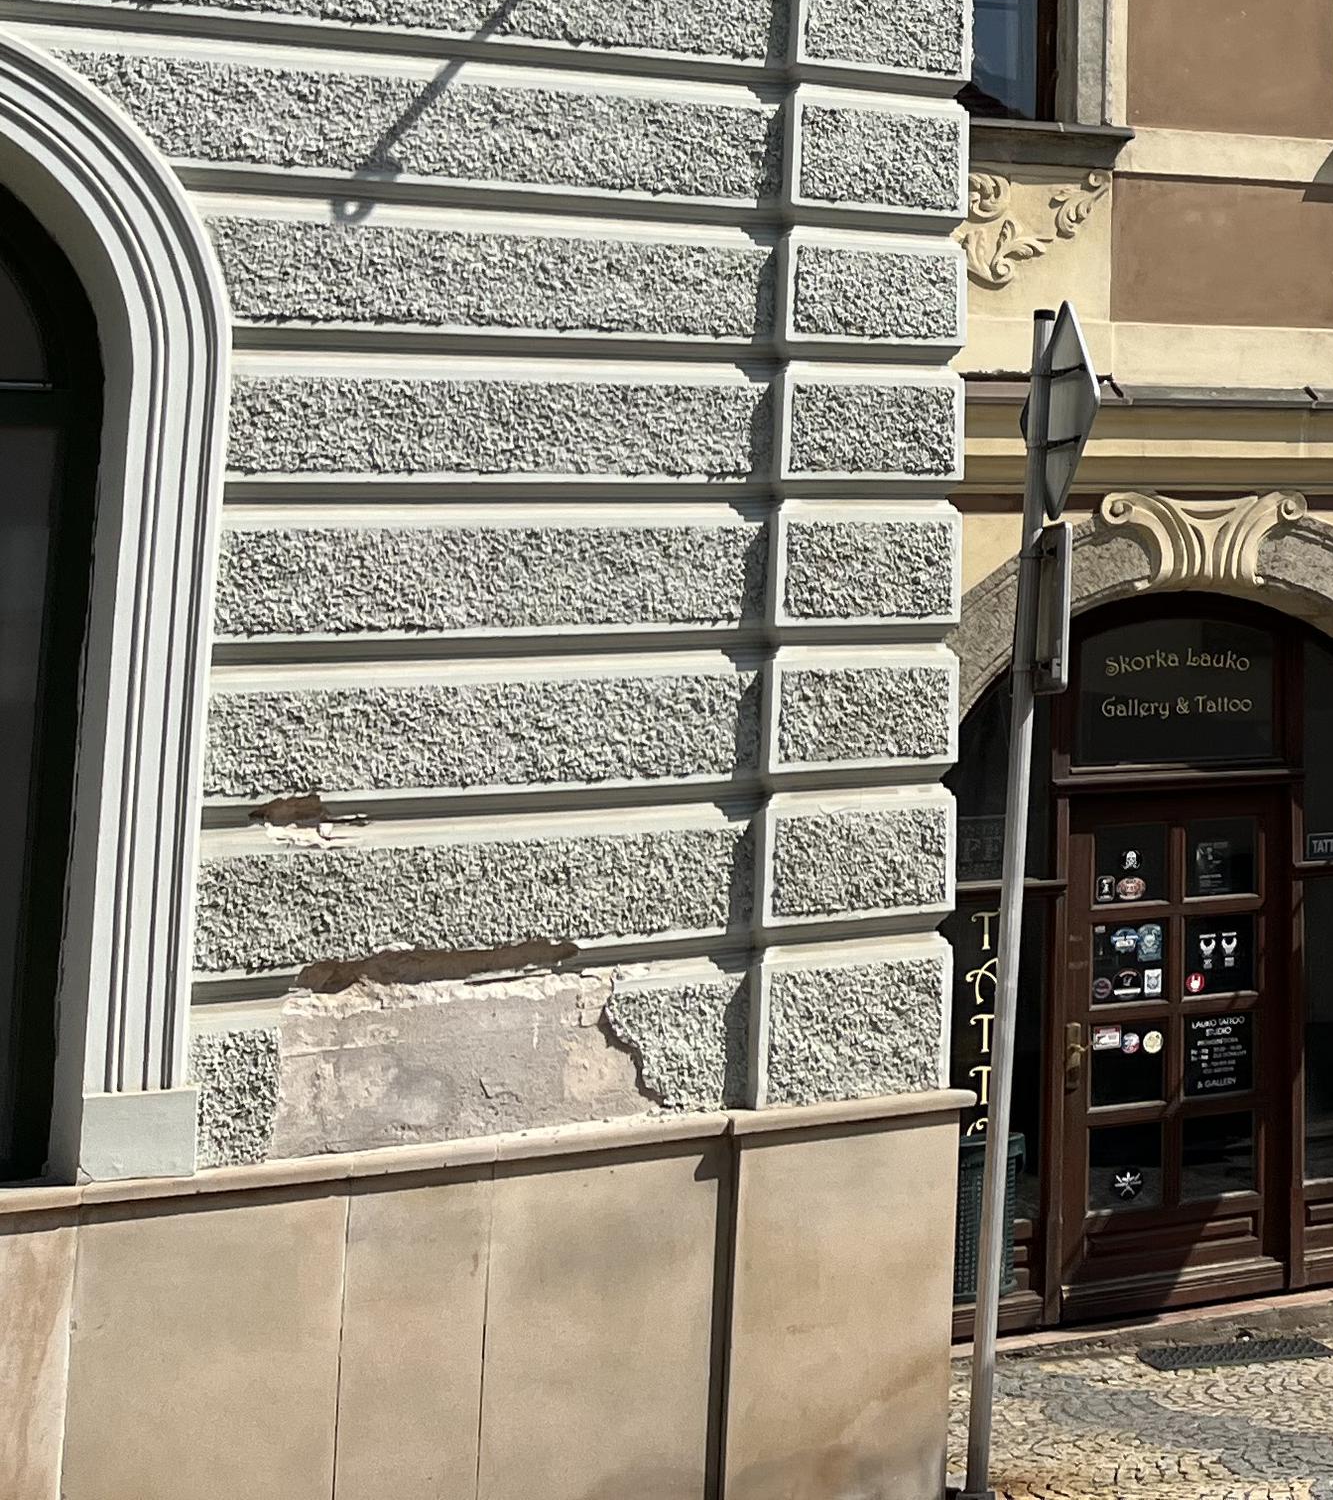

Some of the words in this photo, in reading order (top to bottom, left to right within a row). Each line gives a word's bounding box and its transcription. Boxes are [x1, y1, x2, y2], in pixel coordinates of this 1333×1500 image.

[1105, 649, 1179, 677] Skorka
[1186, 648, 1250, 672] Lauko
[1101, 696, 1170, 720] Gallery
[1175, 696, 1190, 715] &
[1194, 695, 1252, 714] Tattoo
